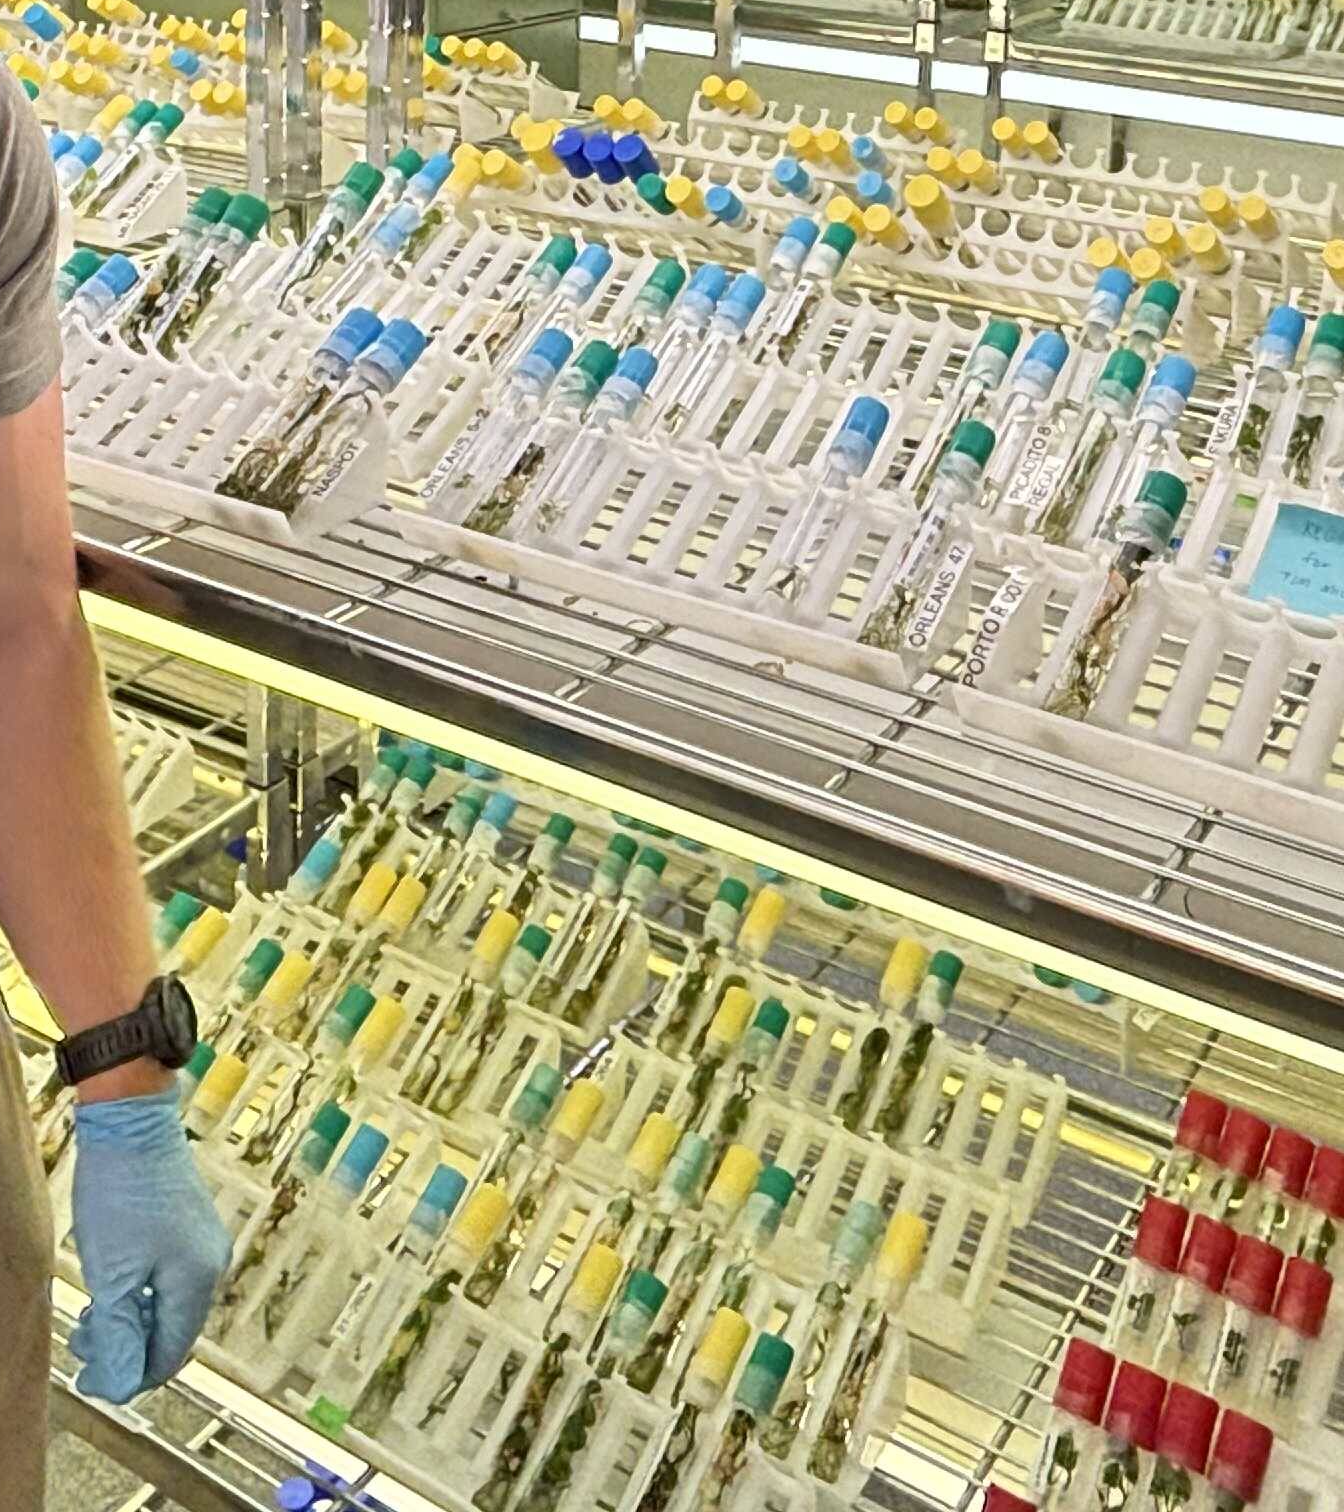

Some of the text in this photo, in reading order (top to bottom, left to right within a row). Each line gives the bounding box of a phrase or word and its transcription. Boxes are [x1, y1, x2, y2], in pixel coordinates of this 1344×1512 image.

[311, 441, 359, 497] NASPOT
[908, 570, 956, 648] ORLEANS
[961, 617, 1000, 690] PORTO
